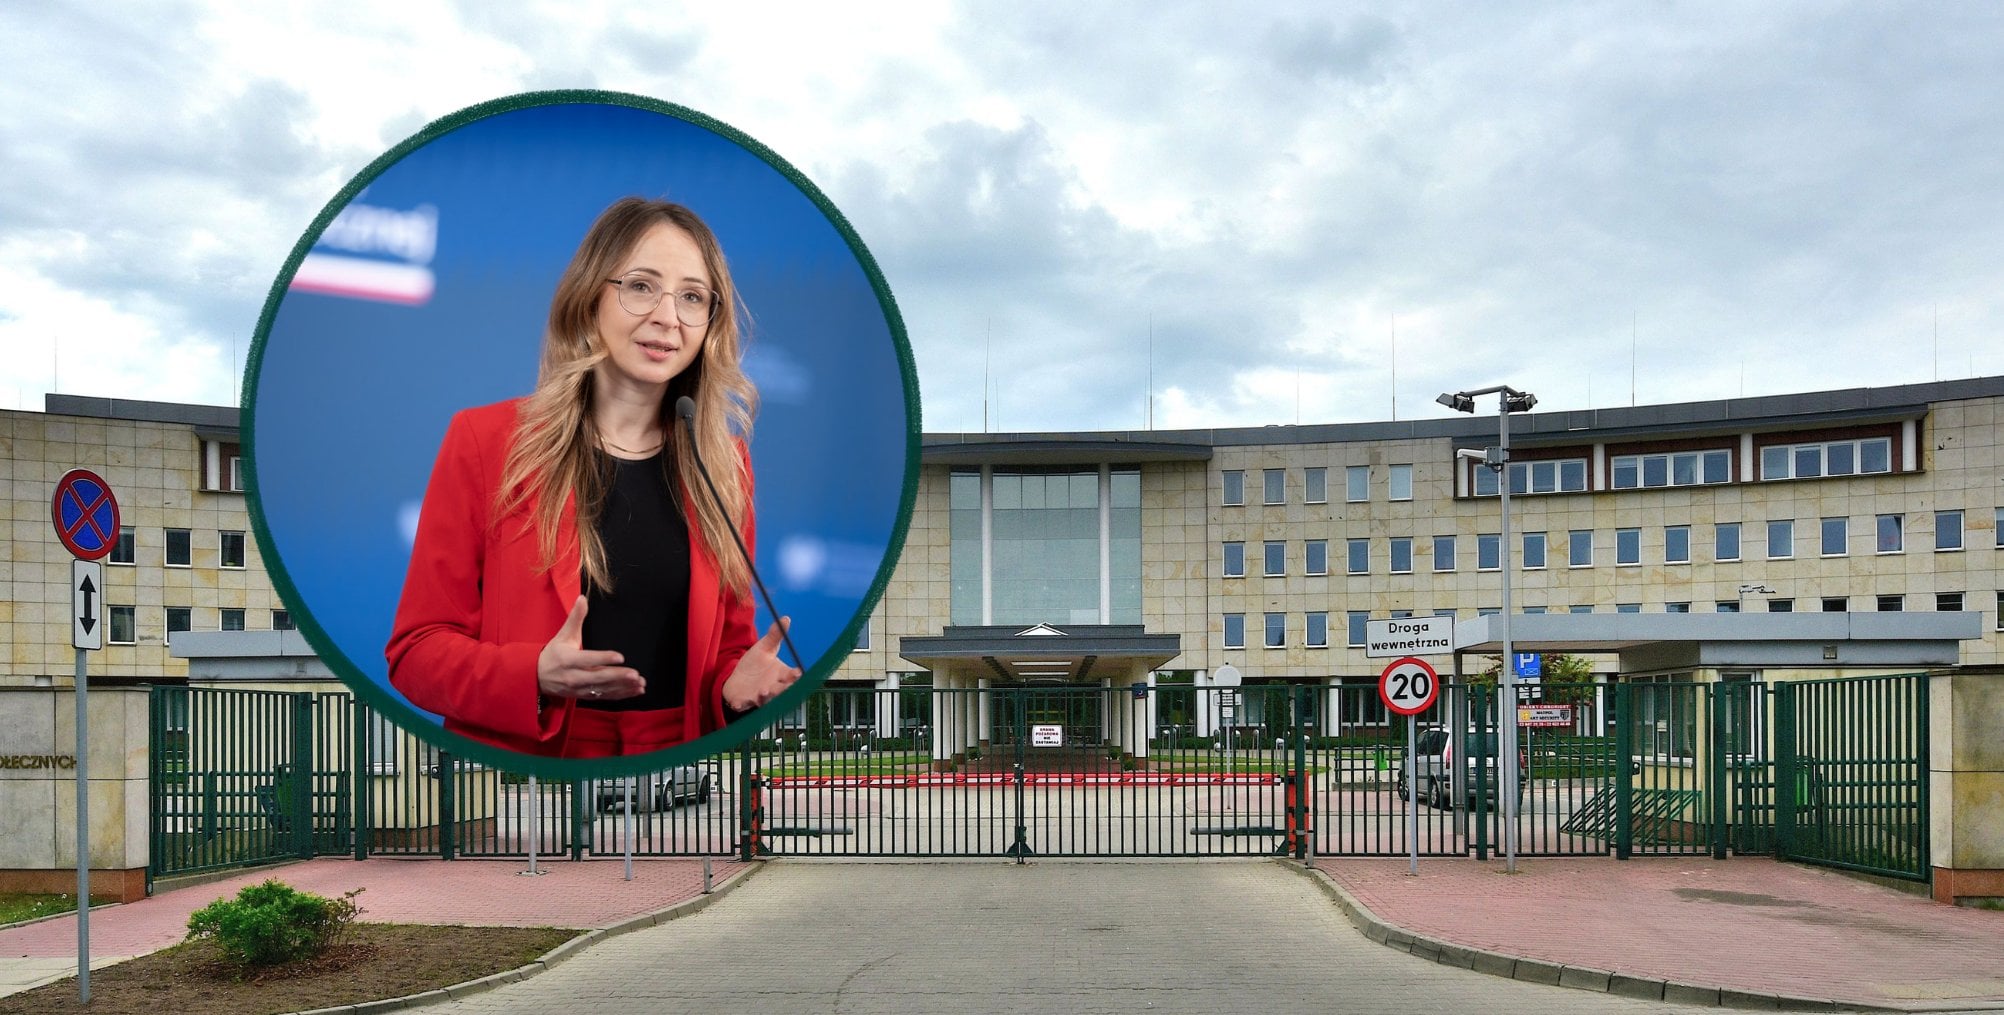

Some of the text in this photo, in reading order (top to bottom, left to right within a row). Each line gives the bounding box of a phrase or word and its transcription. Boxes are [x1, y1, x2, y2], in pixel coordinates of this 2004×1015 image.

[1388, 622, 1429, 635] Droga
[1371, 638, 1449, 651] wewnętrzna
[1519, 653, 1535, 669] P
[1392, 673, 1430, 700] 20
